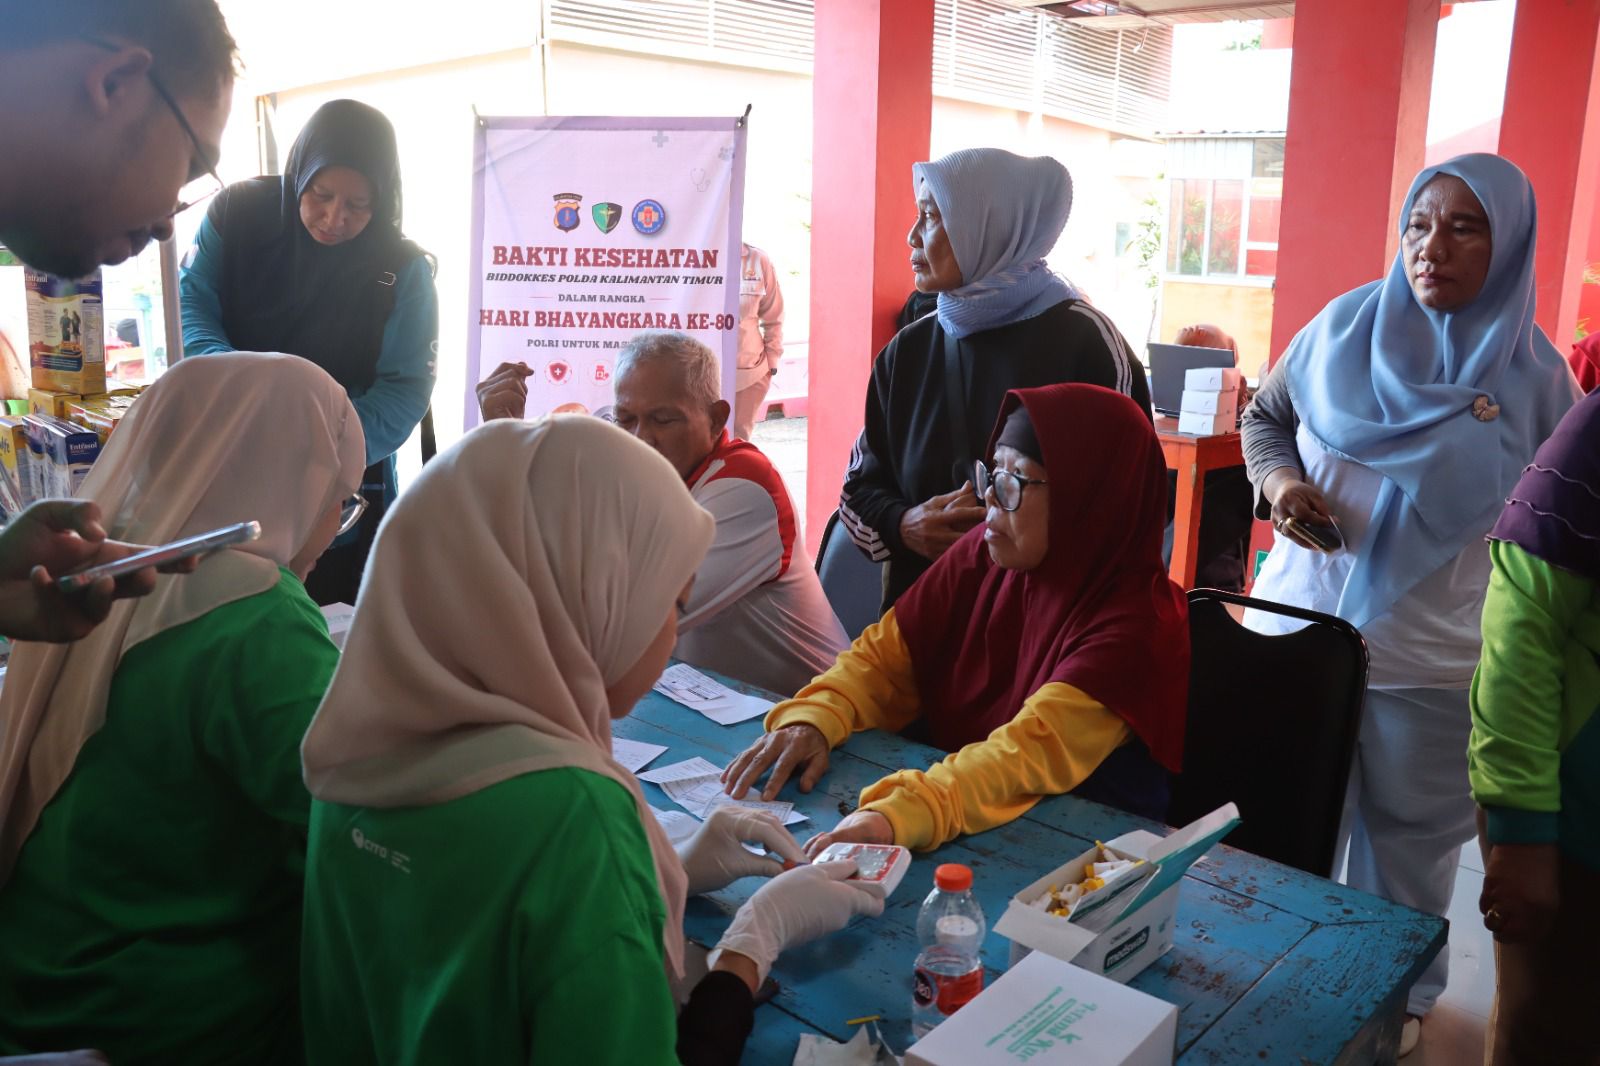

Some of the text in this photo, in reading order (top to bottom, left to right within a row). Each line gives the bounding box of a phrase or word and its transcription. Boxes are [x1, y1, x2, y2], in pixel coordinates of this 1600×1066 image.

[492, 246, 719, 269] BAKTI KESEHATAN
[485, 272, 724, 285] BIDDOKKES POLDA KALIMANTAN TIMUR
[558, 294, 645, 304] DALAM RANGKA
[479, 309, 735, 331] HARI BHAYANGKARA KE-80
[527, 339, 559, 348] POLRI
[562, 340, 600, 349] UNTUK
